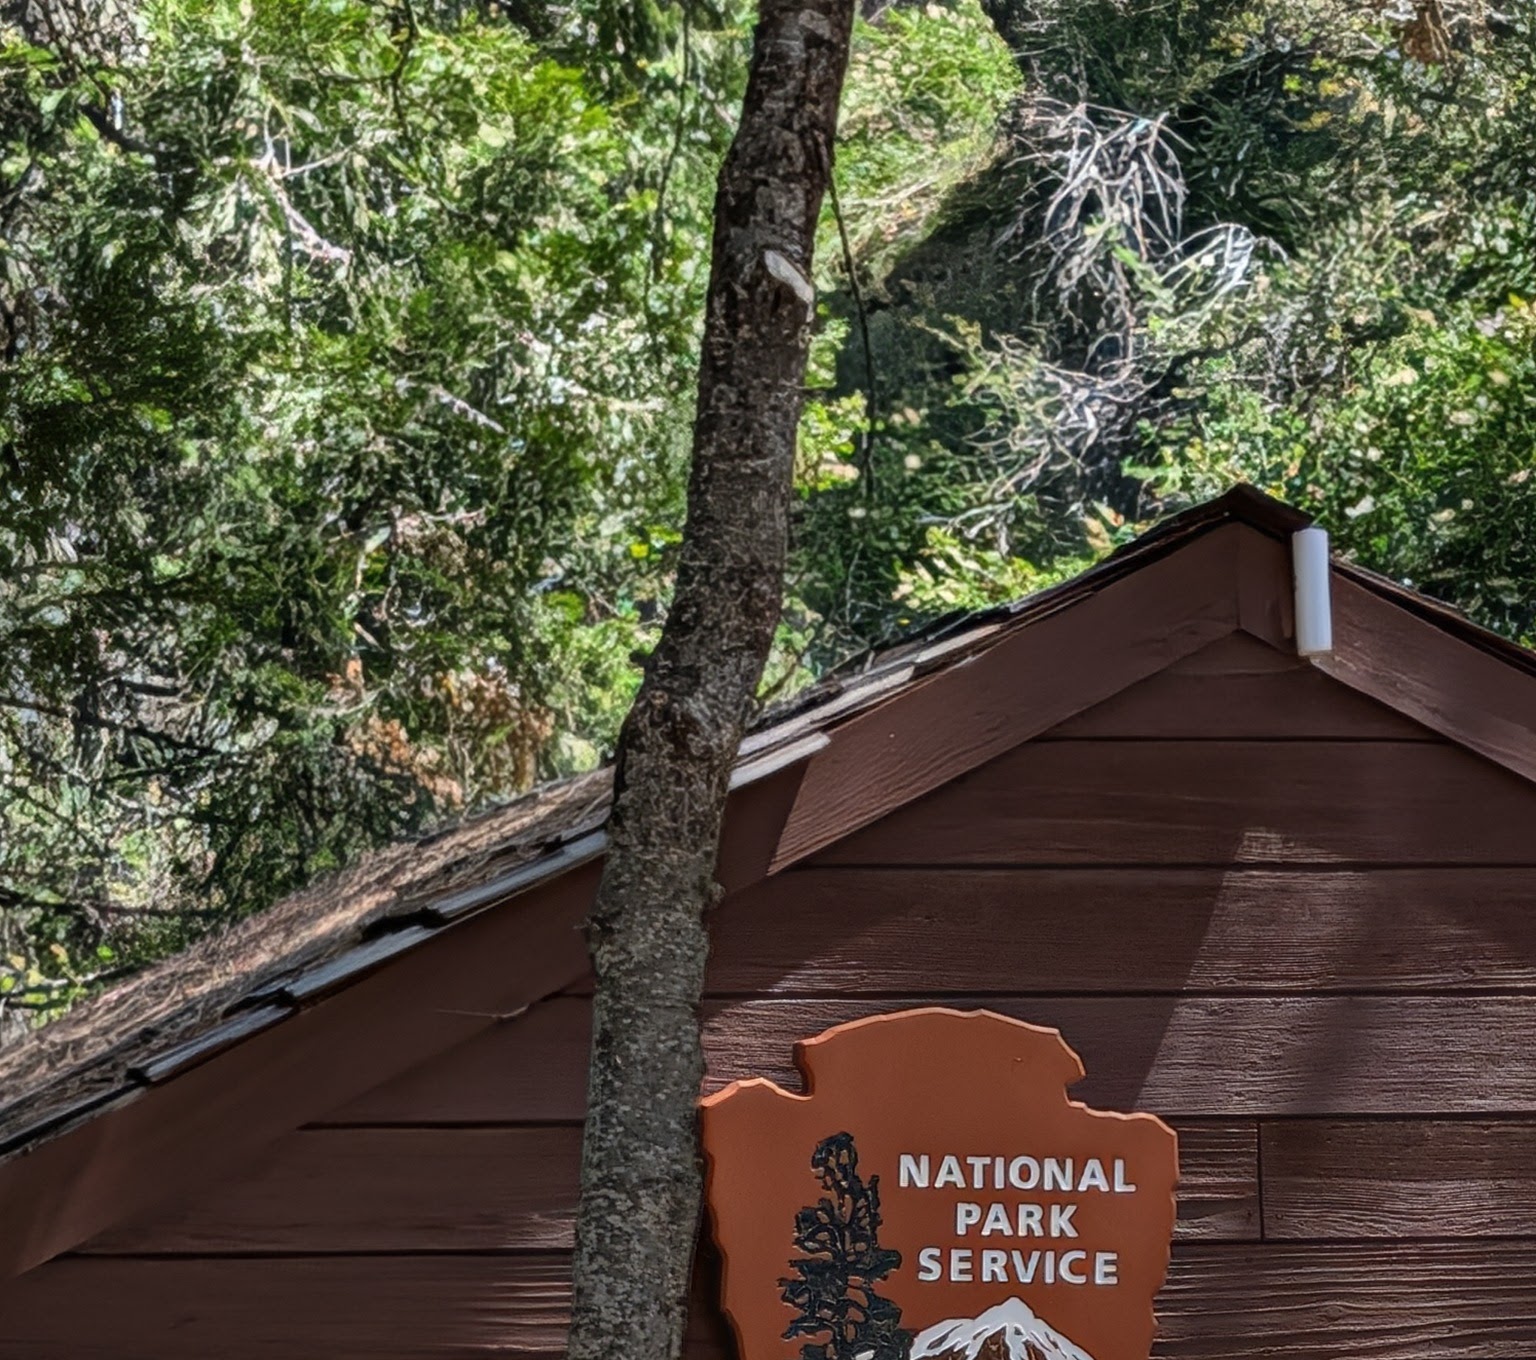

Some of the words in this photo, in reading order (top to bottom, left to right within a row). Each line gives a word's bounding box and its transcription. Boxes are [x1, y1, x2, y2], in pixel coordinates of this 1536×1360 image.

[899, 1154, 1137, 1192] NATIONAL
[956, 1202, 1079, 1238] PARK
[917, 1247, 1118, 1285] SERVICE
